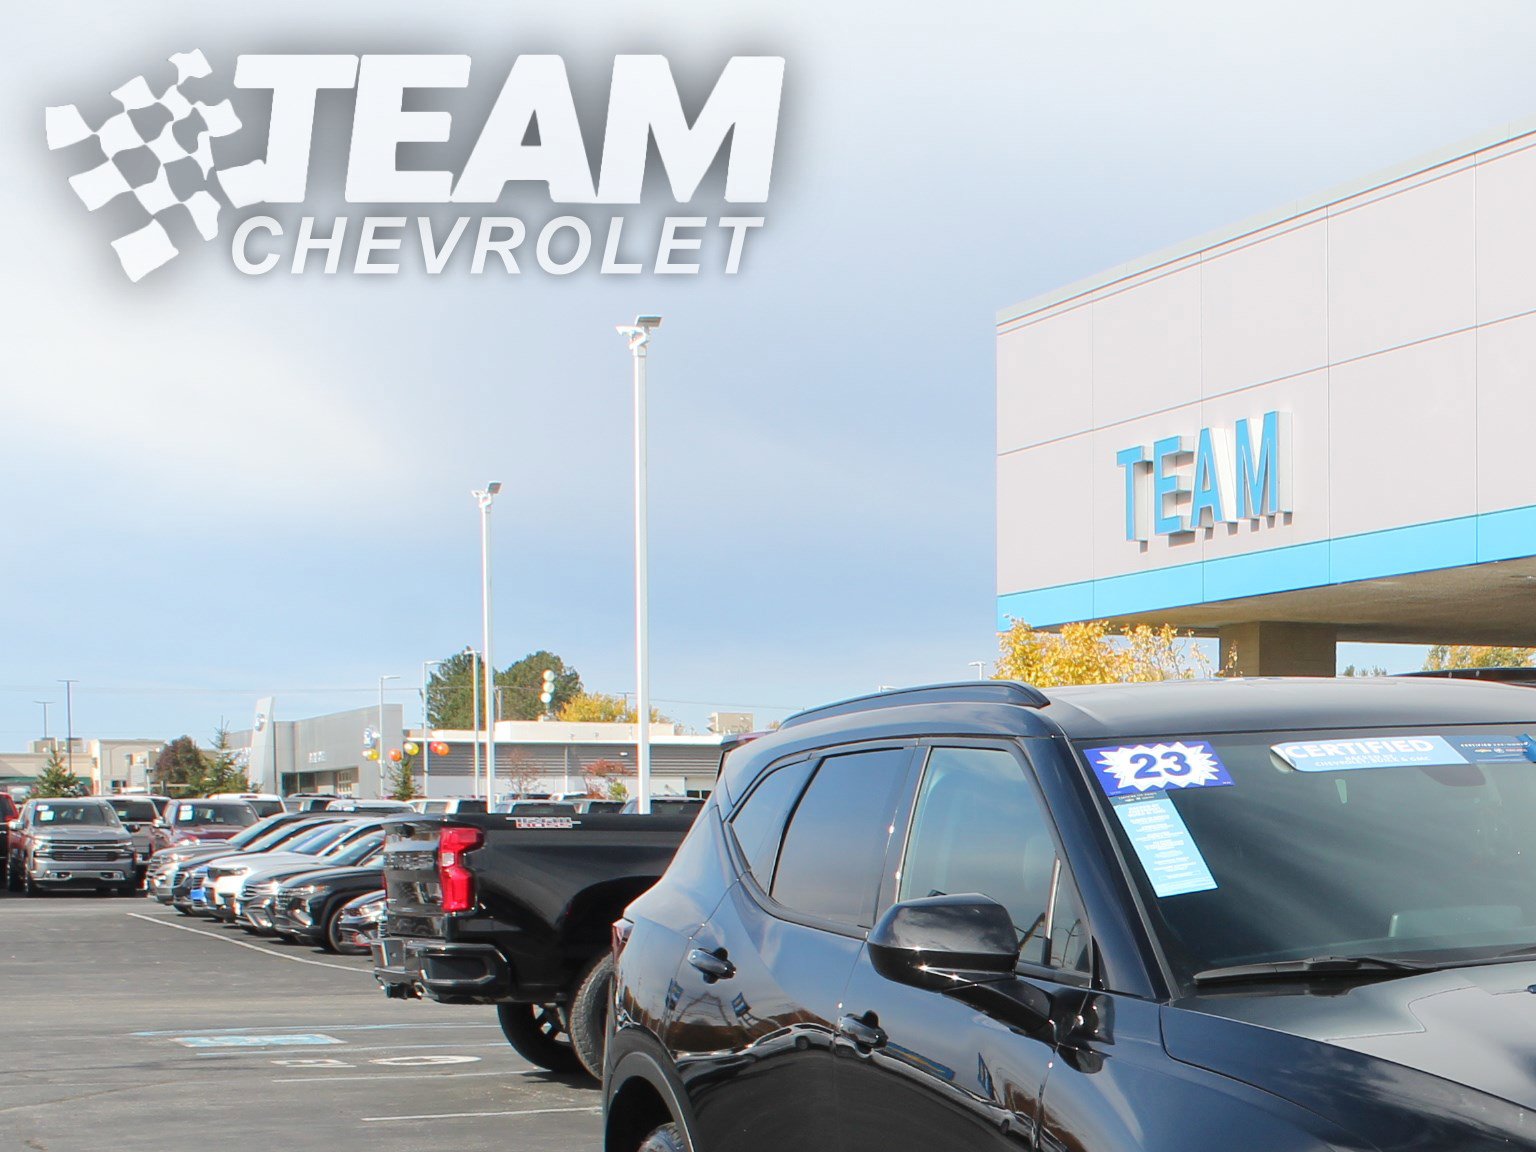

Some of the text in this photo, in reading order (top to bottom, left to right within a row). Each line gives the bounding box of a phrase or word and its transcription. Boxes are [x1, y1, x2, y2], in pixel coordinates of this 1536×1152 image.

[1116, 410, 1282, 542] TEAM
[1284, 739, 1435, 758] CERTIFIED
[1129, 751, 1192, 780] 23
